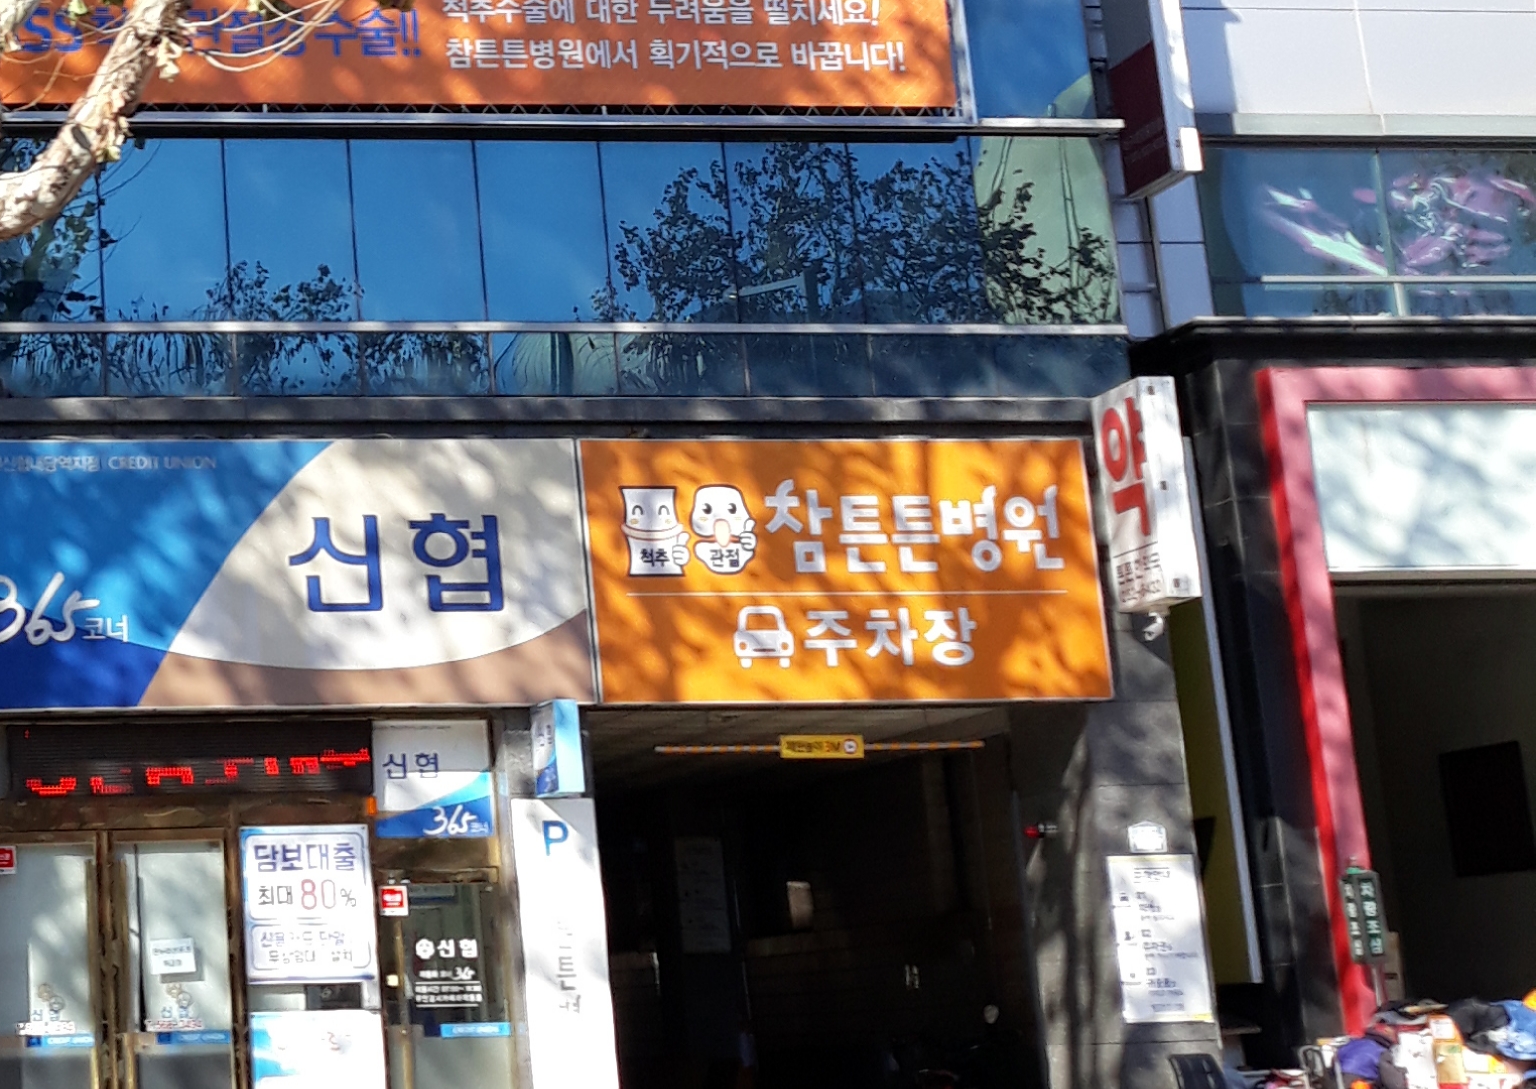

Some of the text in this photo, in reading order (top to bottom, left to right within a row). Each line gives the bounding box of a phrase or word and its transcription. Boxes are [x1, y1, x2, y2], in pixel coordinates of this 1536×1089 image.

[445, 38, 906, 72] 참튼튼병원에서 획기적으로 바꿉니다!
[107, 455, 217, 471] CREDIT UNION
[1101, 396, 1151, 537] 약
[764, 478, 1066, 573] 참튼튼병원
[289, 513, 504, 612] 신협
[640, 548, 670, 567] 척추
[709, 548, 740, 568] 관절
[803, 606, 977, 668] 주차장
[542, 820, 569, 856] P
[253, 842, 357, 872] 담보대출
[258, 885, 293, 906] 최대
